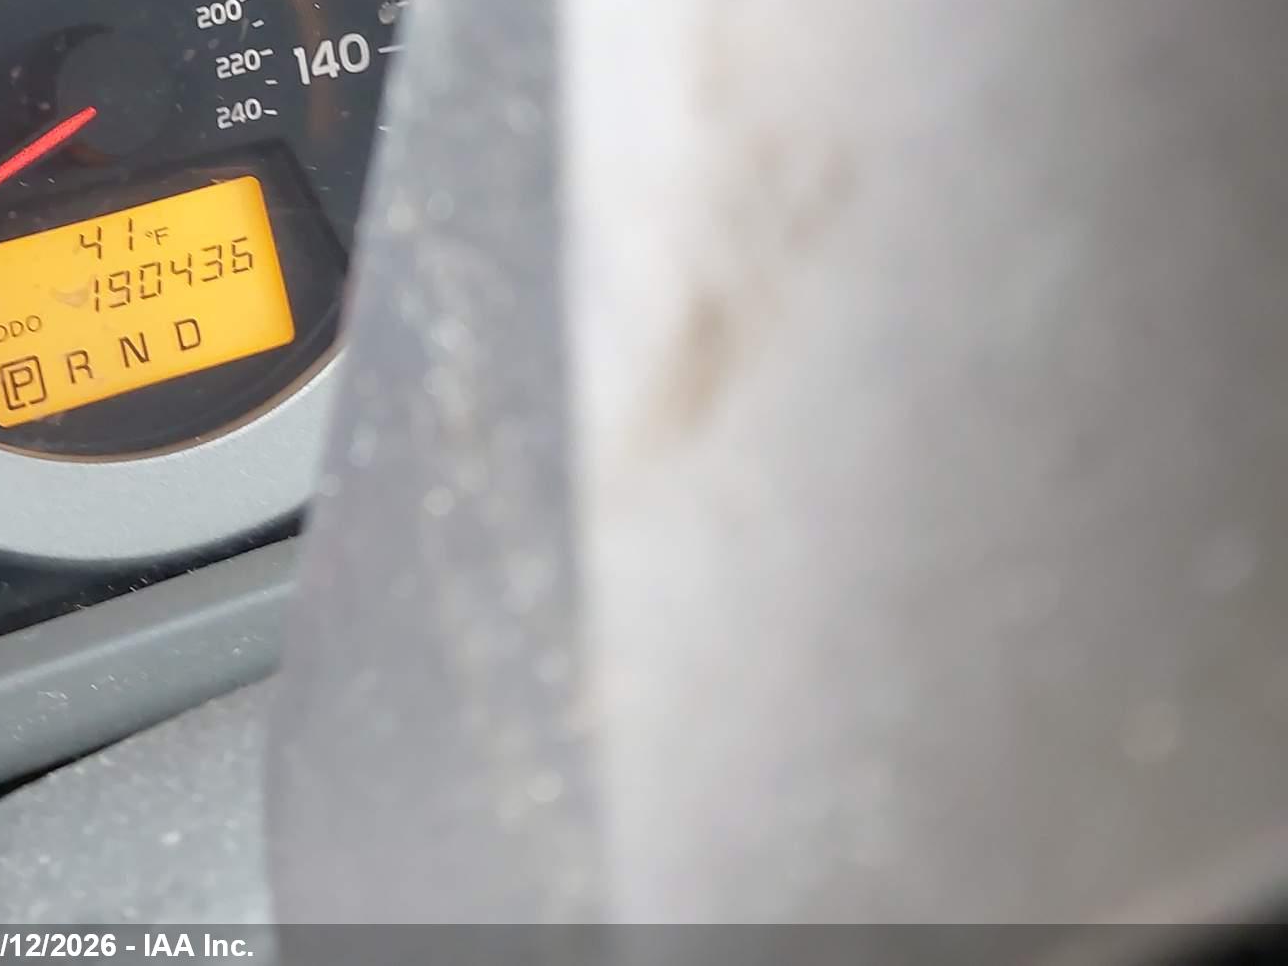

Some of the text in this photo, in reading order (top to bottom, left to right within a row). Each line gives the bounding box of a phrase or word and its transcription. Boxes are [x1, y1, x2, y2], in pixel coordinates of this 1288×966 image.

[196, 0, 242, 29] 200
[216, 49, 261, 79] 220
[293, 33, 370, 85] 140
[216, 98, 262, 130] 240
[79, 217, 134, 260] 41
[94, 237, 254, 313] 190436
[10, 318, 202, 402] P R N D
